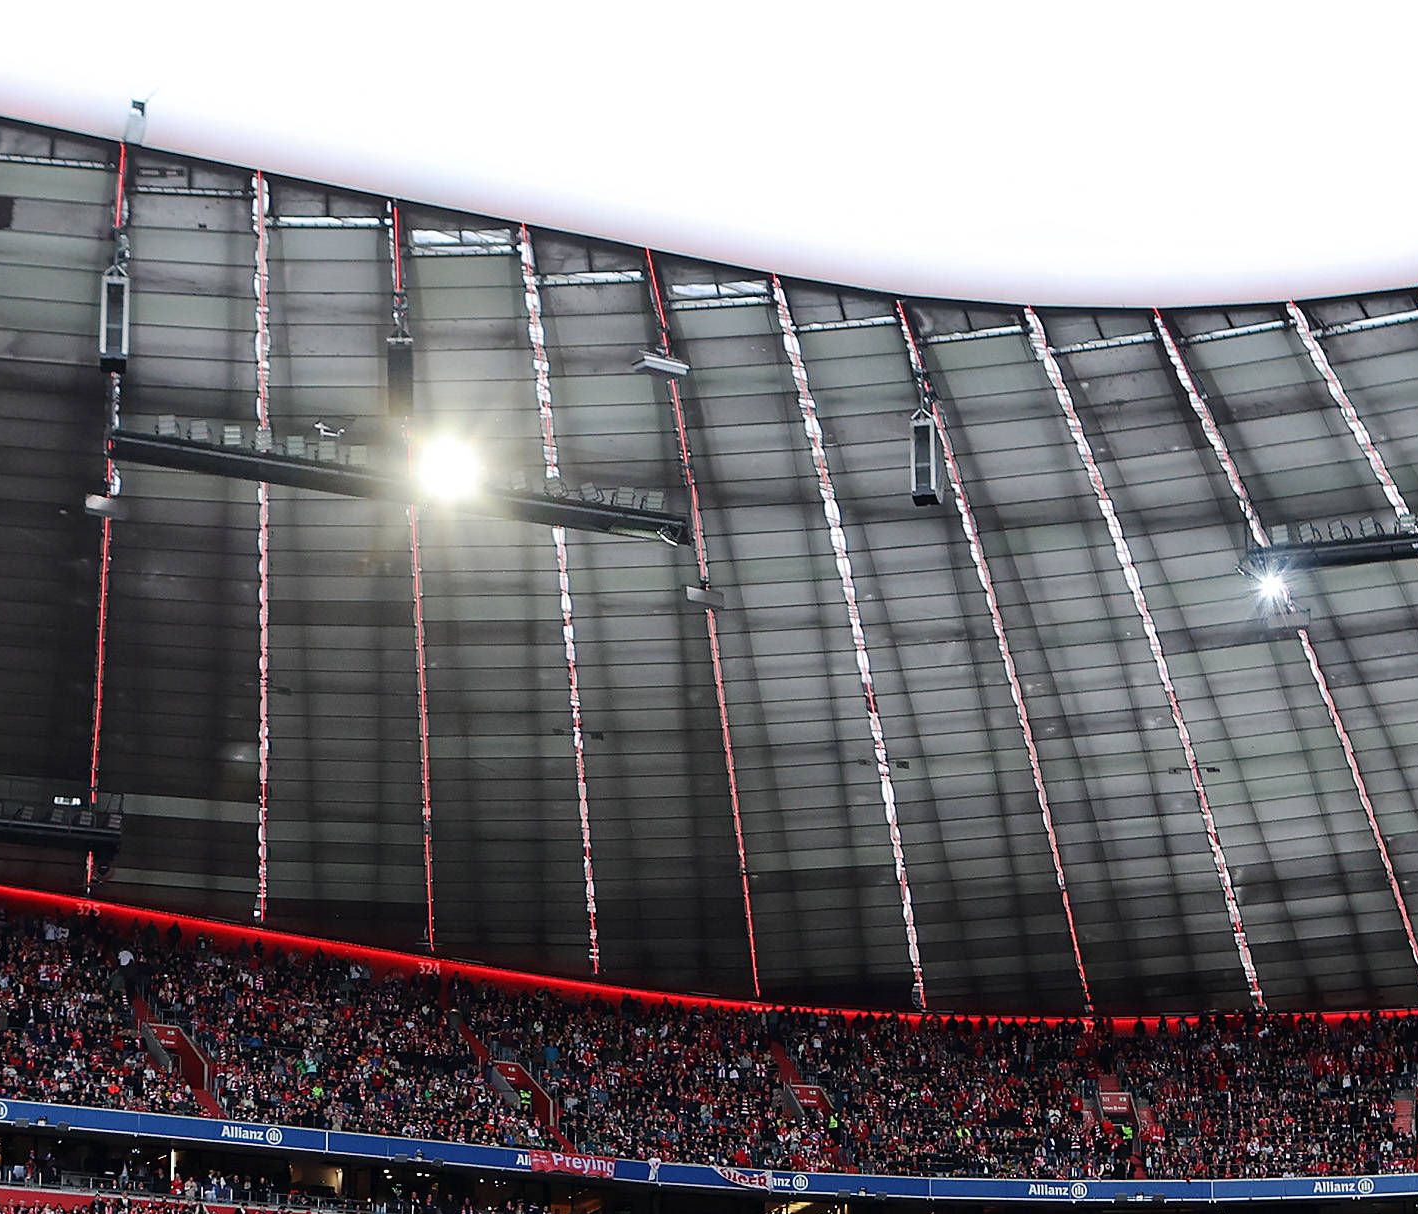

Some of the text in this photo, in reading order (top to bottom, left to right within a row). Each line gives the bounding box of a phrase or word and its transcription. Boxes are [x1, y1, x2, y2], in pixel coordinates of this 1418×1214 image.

[221, 1125, 264, 1140] Allianz
[552, 1153, 614, 1177] Preying
[1028, 1183, 1069, 1196] Allianz
[1314, 1181, 1356, 1193] Allianz
